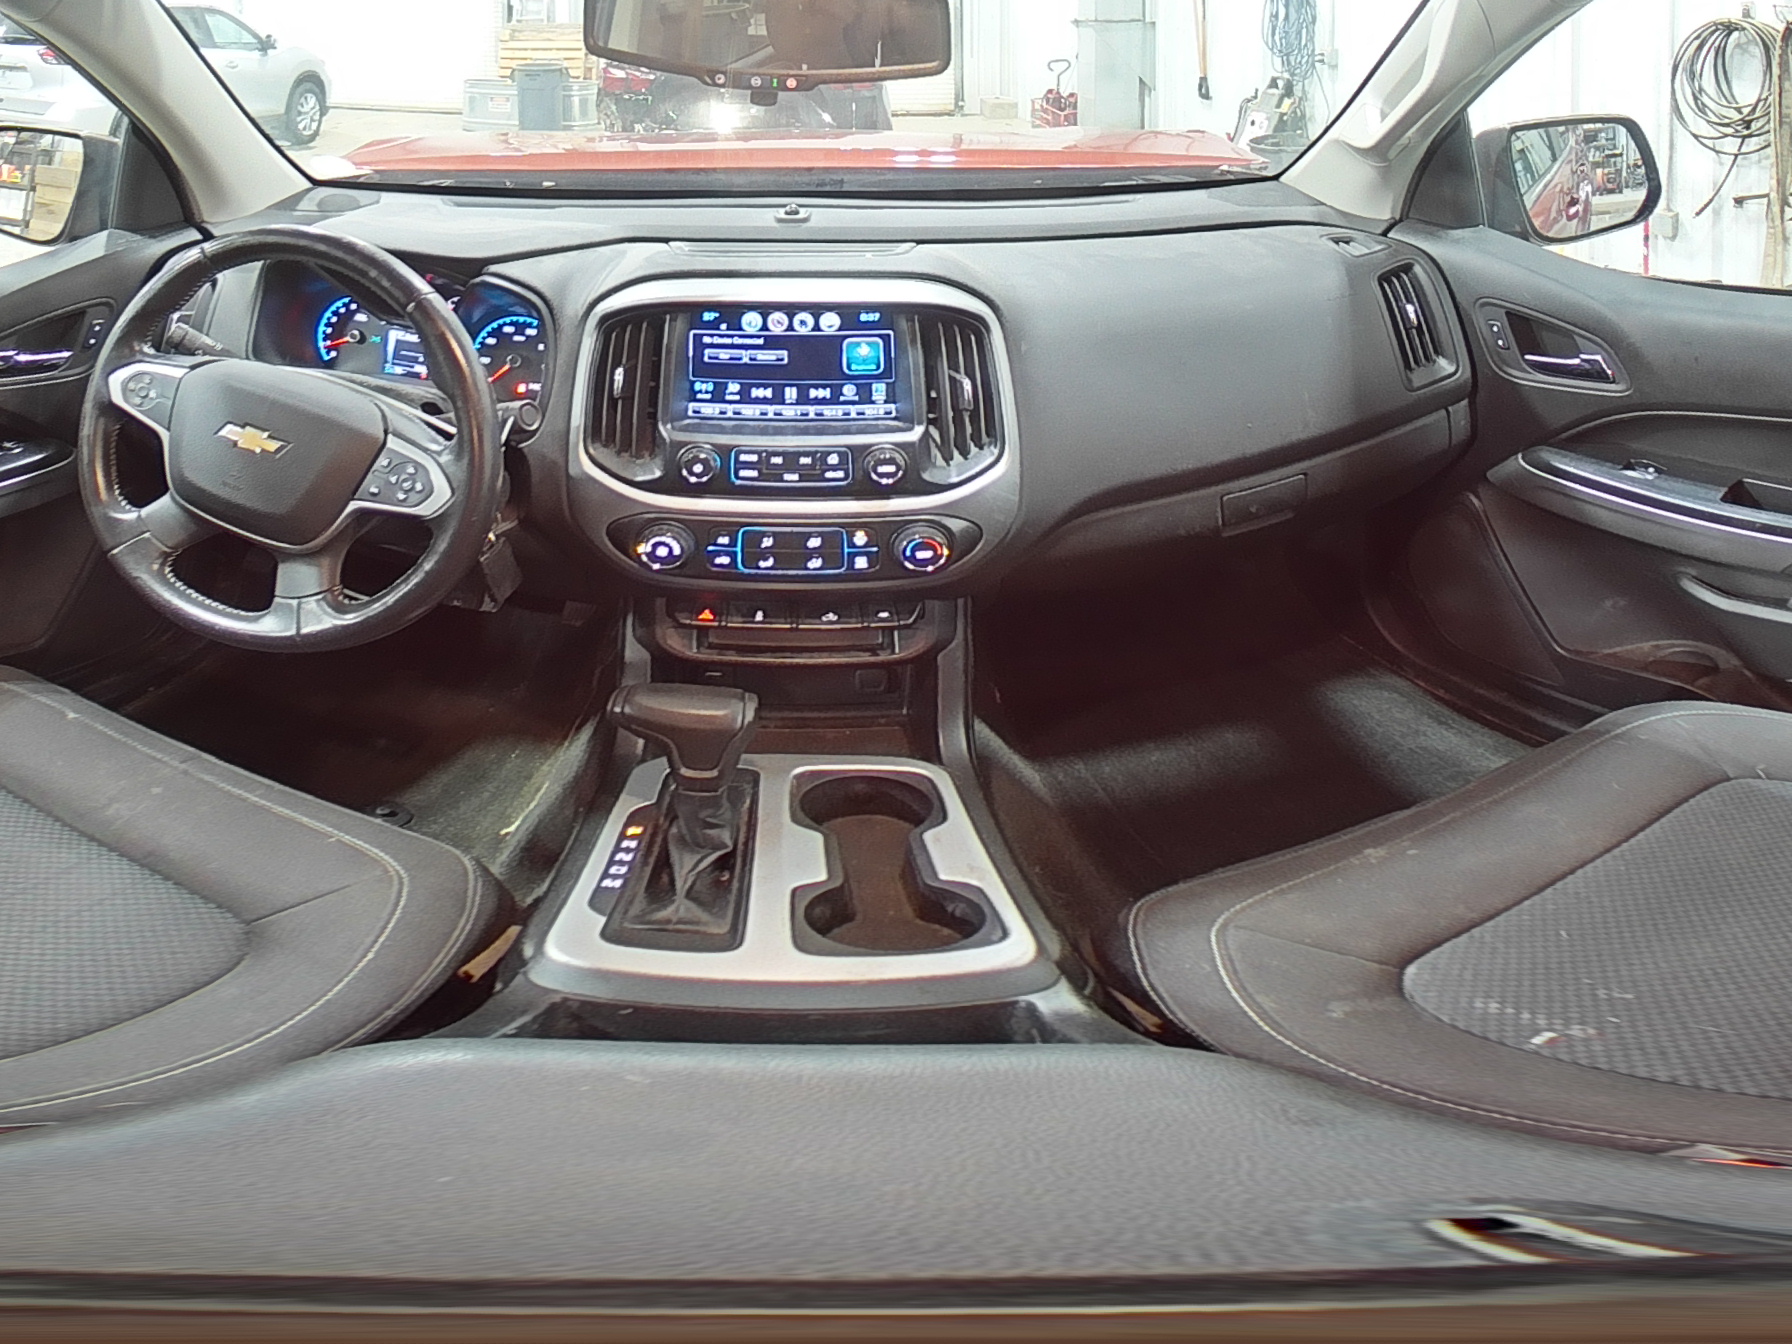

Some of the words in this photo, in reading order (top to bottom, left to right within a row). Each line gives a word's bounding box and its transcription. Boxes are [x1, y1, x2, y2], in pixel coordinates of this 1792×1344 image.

[613, 851, 635, 861] N
[608, 864, 628, 875] D
[600, 878, 624, 888] M
